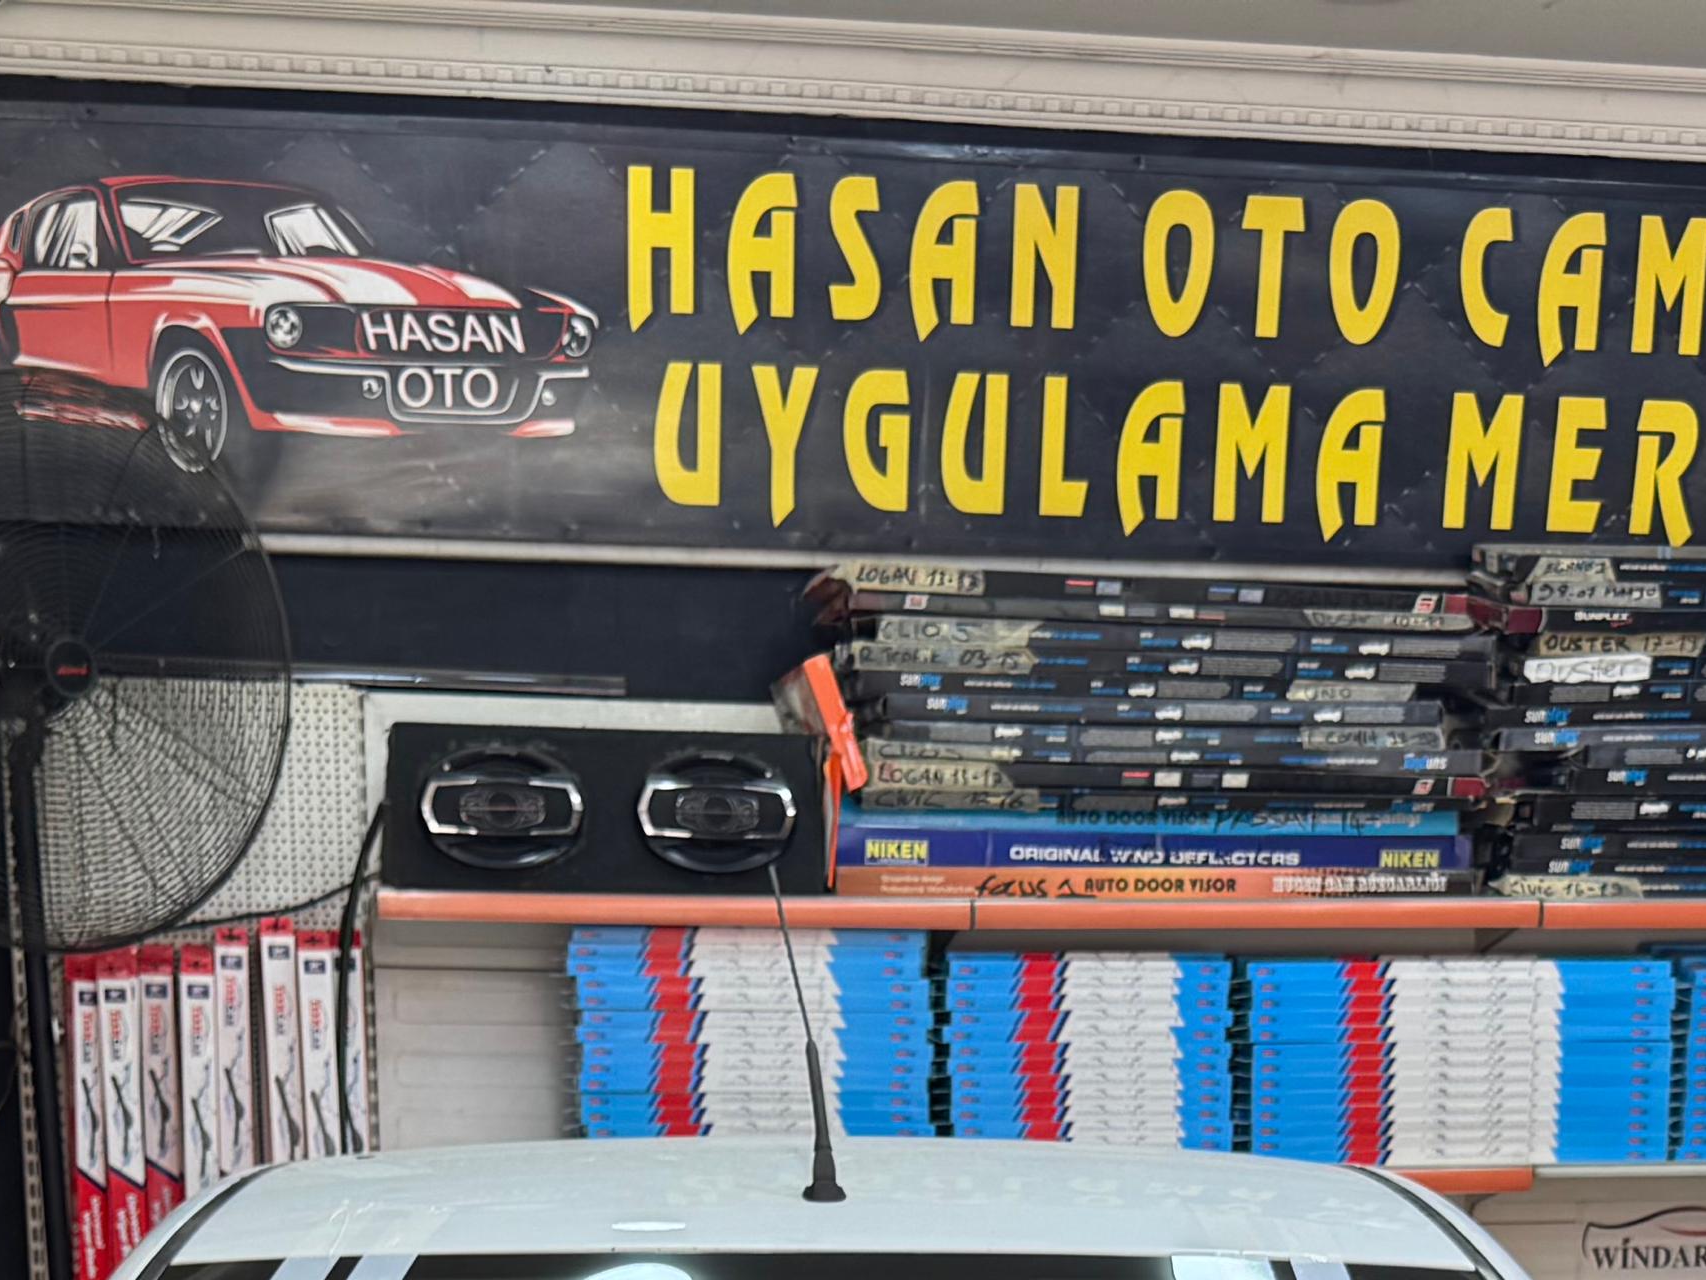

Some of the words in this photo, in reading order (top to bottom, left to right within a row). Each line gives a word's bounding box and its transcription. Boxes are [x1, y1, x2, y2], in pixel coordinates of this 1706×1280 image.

[627, 165, 1081, 343] HASAN
[1143, 189, 1401, 346] OTO
[361, 311, 526, 353] HASAN
[397, 366, 499, 409] OTO
[654, 361, 1387, 541] UYGULAMA
[866, 839, 929, 860] NIKEN
[1009, 845, 1105, 864] ORIGINAL
[1379, 850, 1440, 869] NIKEN
[1084, 878, 1129, 893] AUTO
[1134, 878, 1185, 893] DOOR
[1190, 878, 1237, 893] VISOR
